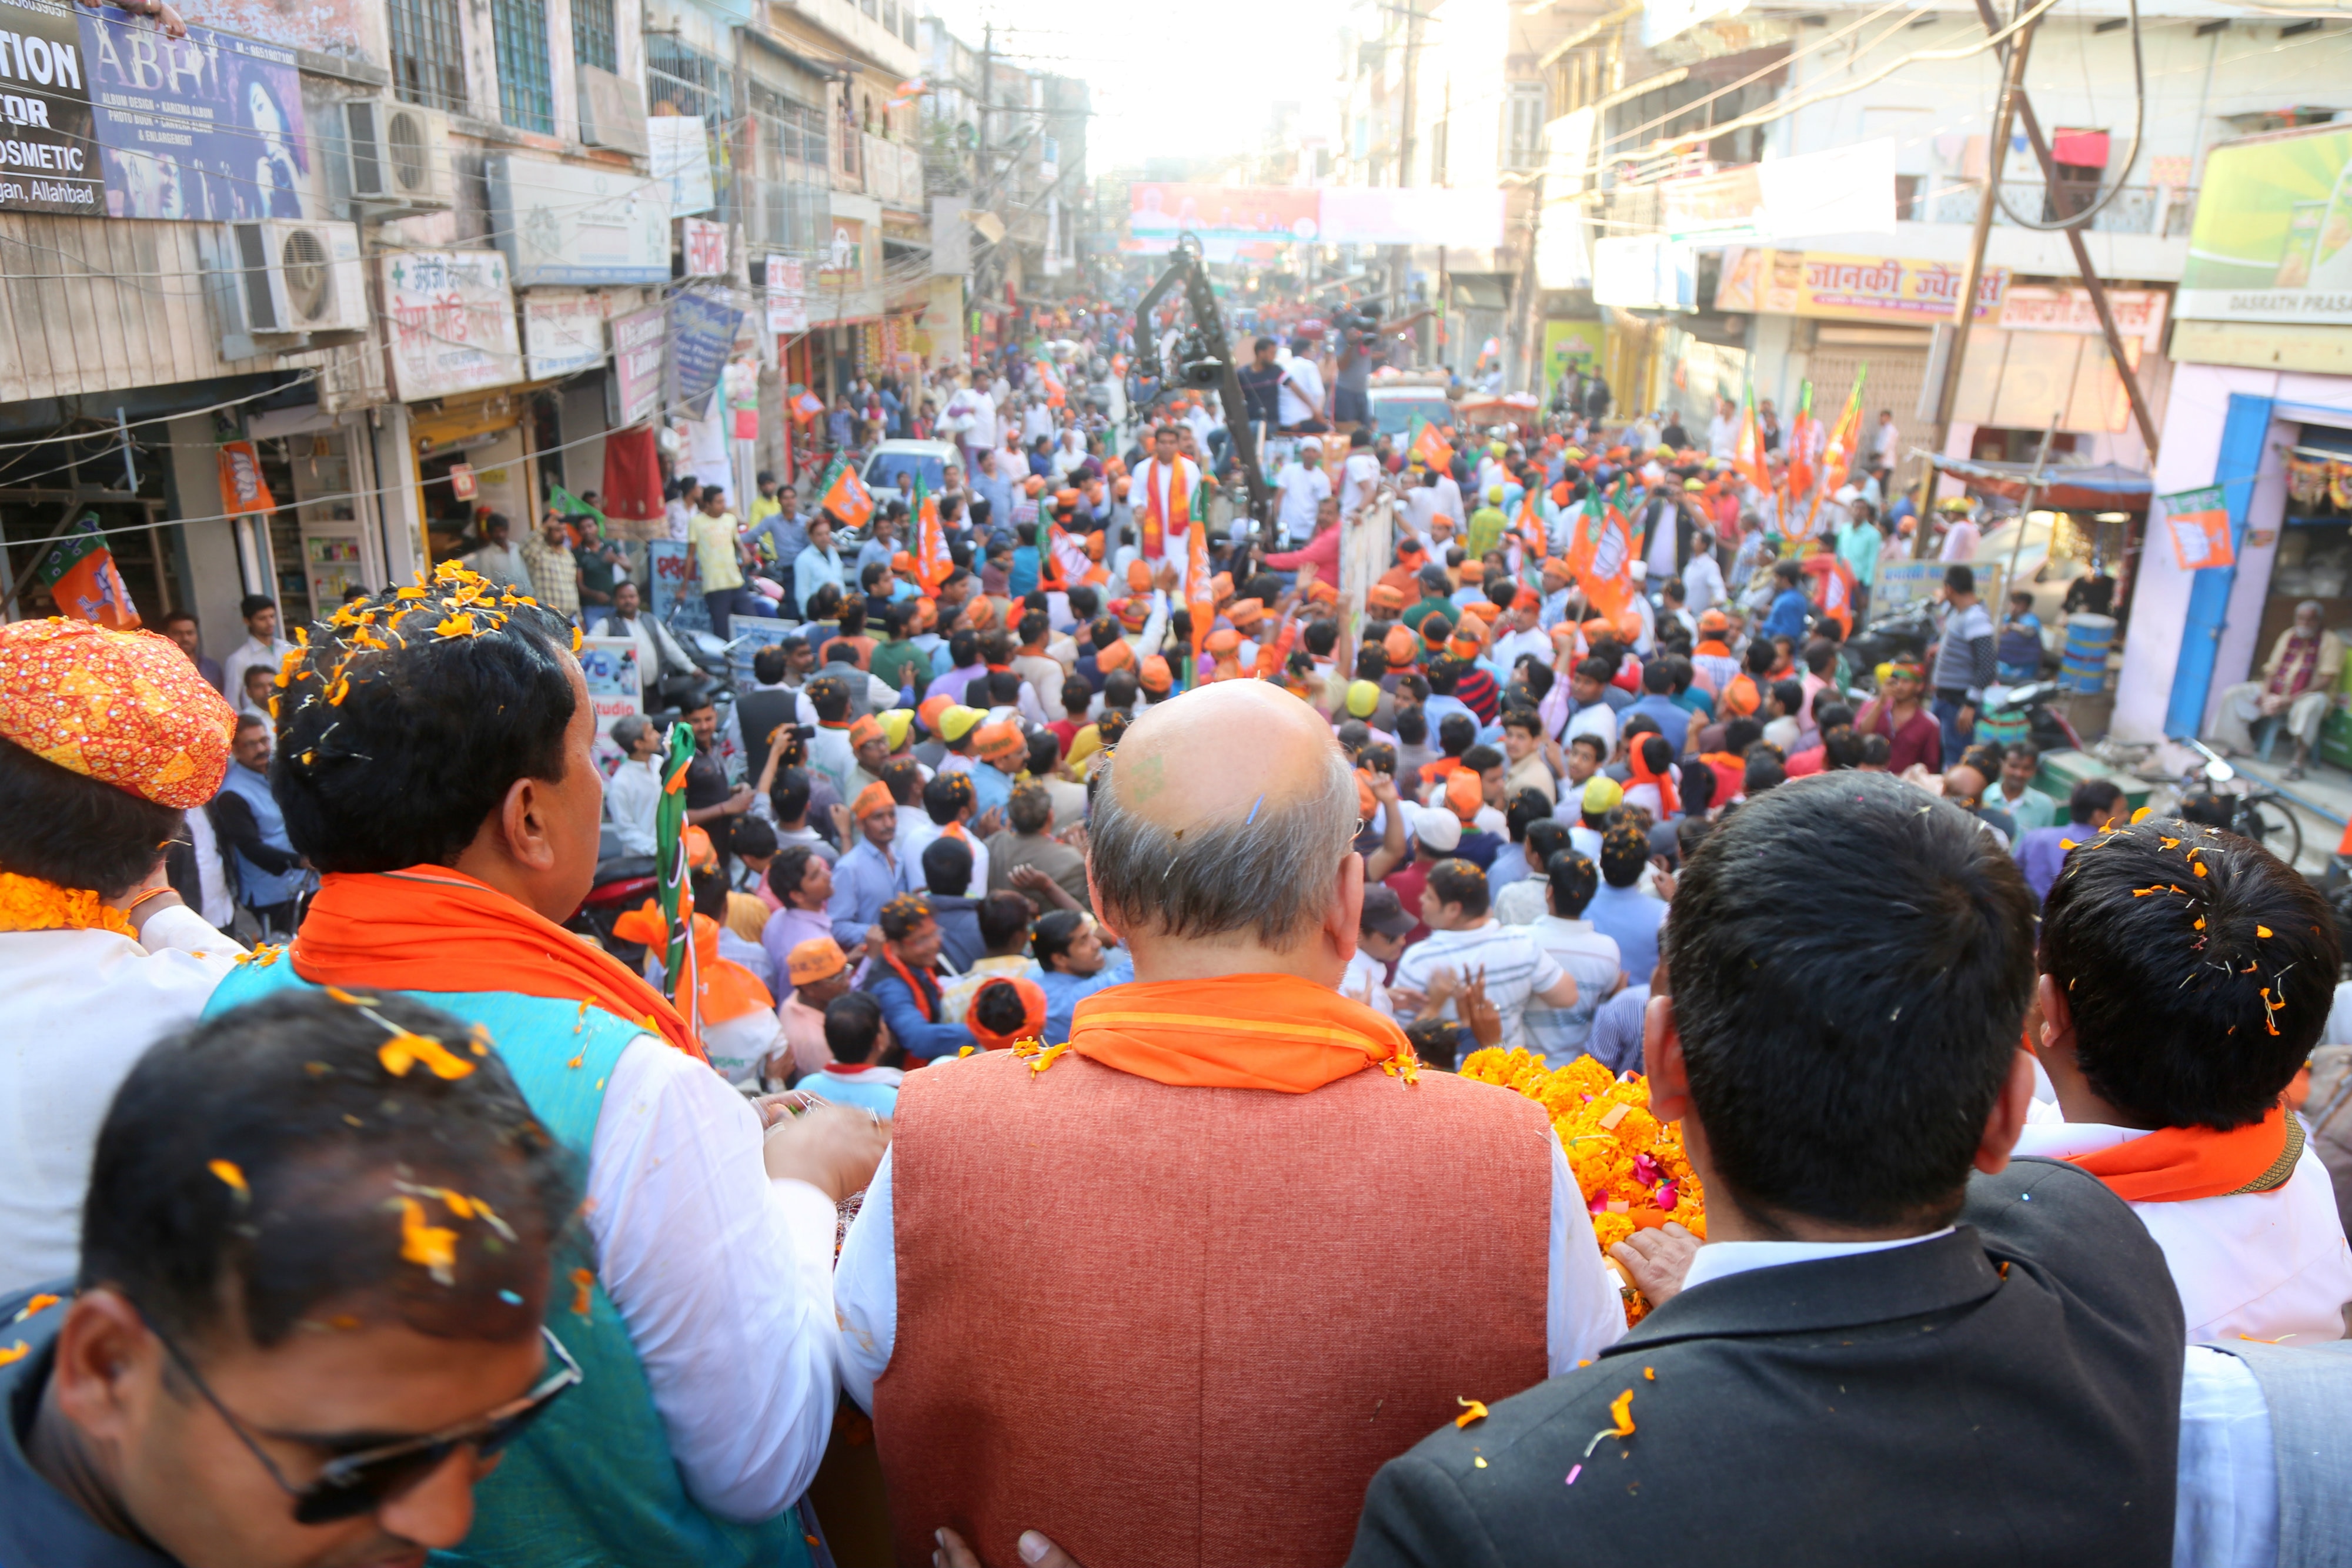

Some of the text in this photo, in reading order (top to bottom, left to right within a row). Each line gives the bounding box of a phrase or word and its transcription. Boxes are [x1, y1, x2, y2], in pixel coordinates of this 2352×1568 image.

[0, 31, 81, 89] TION
[102, 92, 214, 119] ALBUM DESIGN KARIZMA ALBUM
[108, 109, 133, 123] PHOTO
[138, 129, 193, 146] & ENLARGEMENT
[32, 180, 94, 203] Allahbad
[1806, 259, 1903, 293] जानकी
[2229, 294, 2352, 313] DASRATH PRAS
[592, 700, 634, 716] tudio
